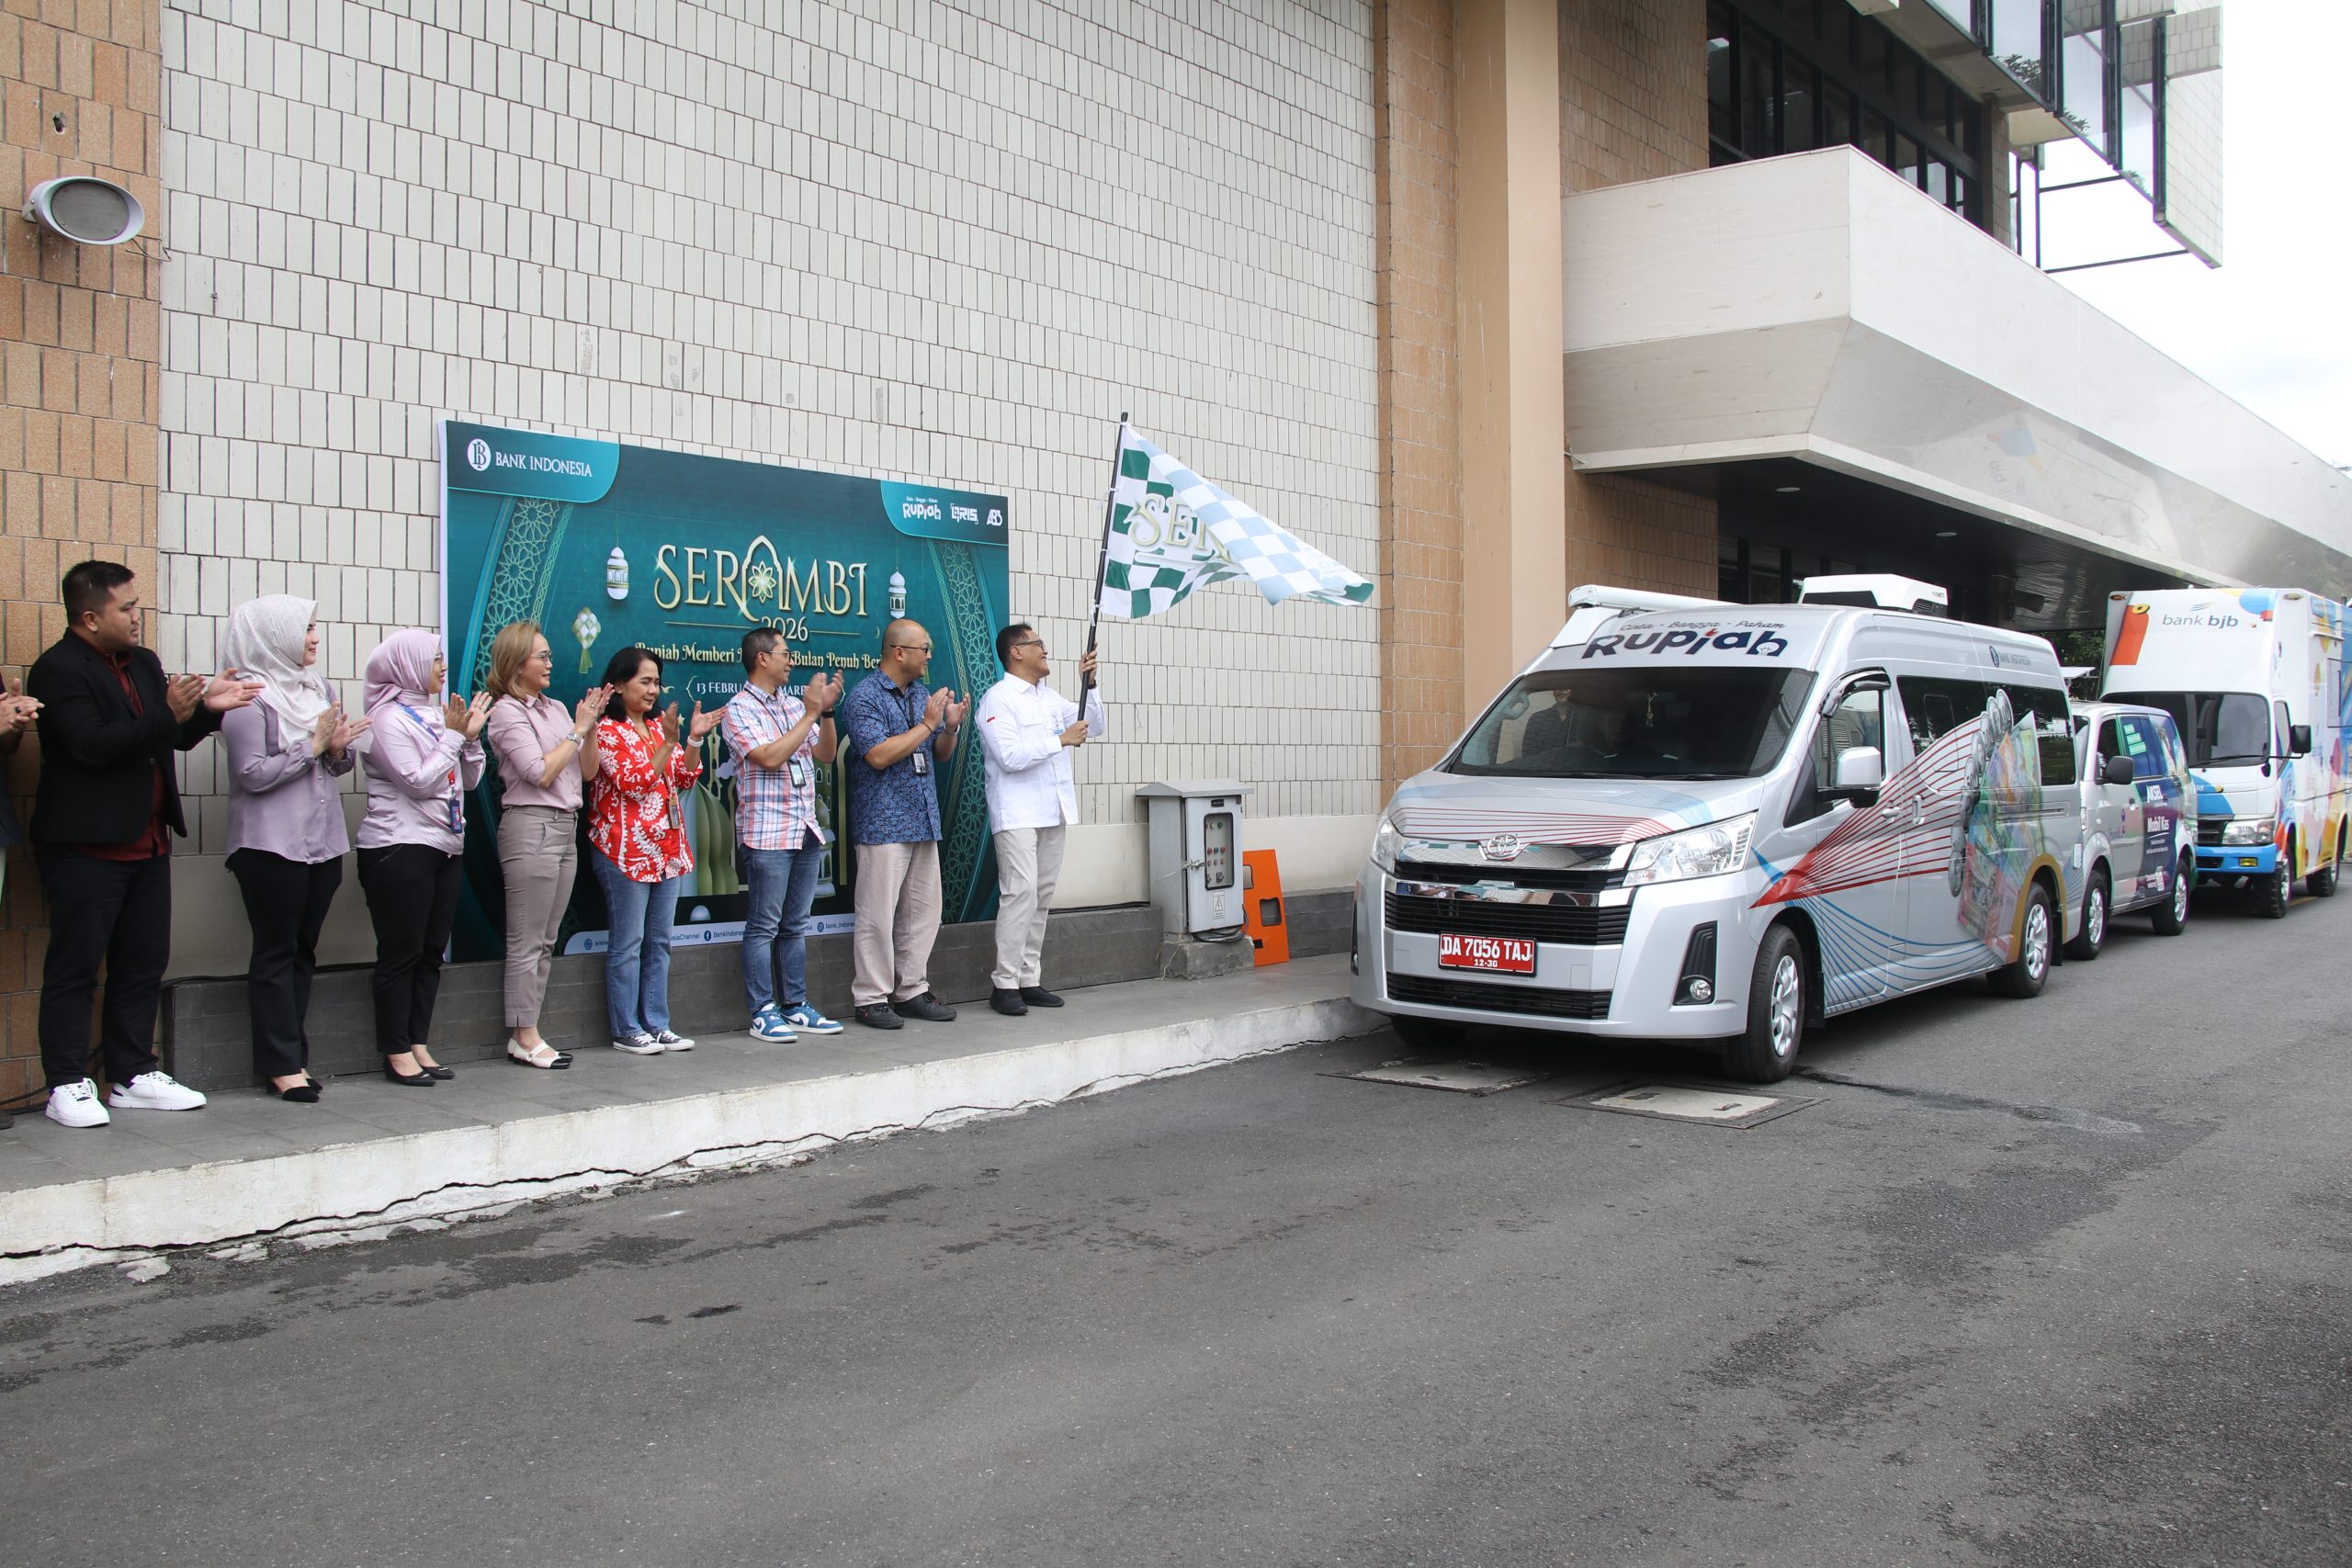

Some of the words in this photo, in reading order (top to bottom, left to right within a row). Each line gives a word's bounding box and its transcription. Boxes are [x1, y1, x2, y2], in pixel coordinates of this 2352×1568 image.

[495, 452, 526, 469] BANK
[529, 456, 593, 478] INDONESIA
[902, 502, 942, 520] Rupiah
[1668, 620, 1722, 629] Bangga
[1735, 620, 1786, 628] Paham
[2162, 615, 2203, 626] bank
[2208, 615, 2239, 629] bjb
[682, 642, 734, 662] Memberi
[1581, 628, 1788, 660] Rupiah
[792, 650, 824, 668] Bulan
[826, 651, 860, 670] Penuh
[861, 653, 882, 669] Ber
[696, 682, 707, 694] 13
[708, 682, 742, 694] FEBRU
[1442, 937, 1462, 955] DA
[1464, 939, 1500, 959] 7056
[1503, 942, 1532, 962] TAJ
